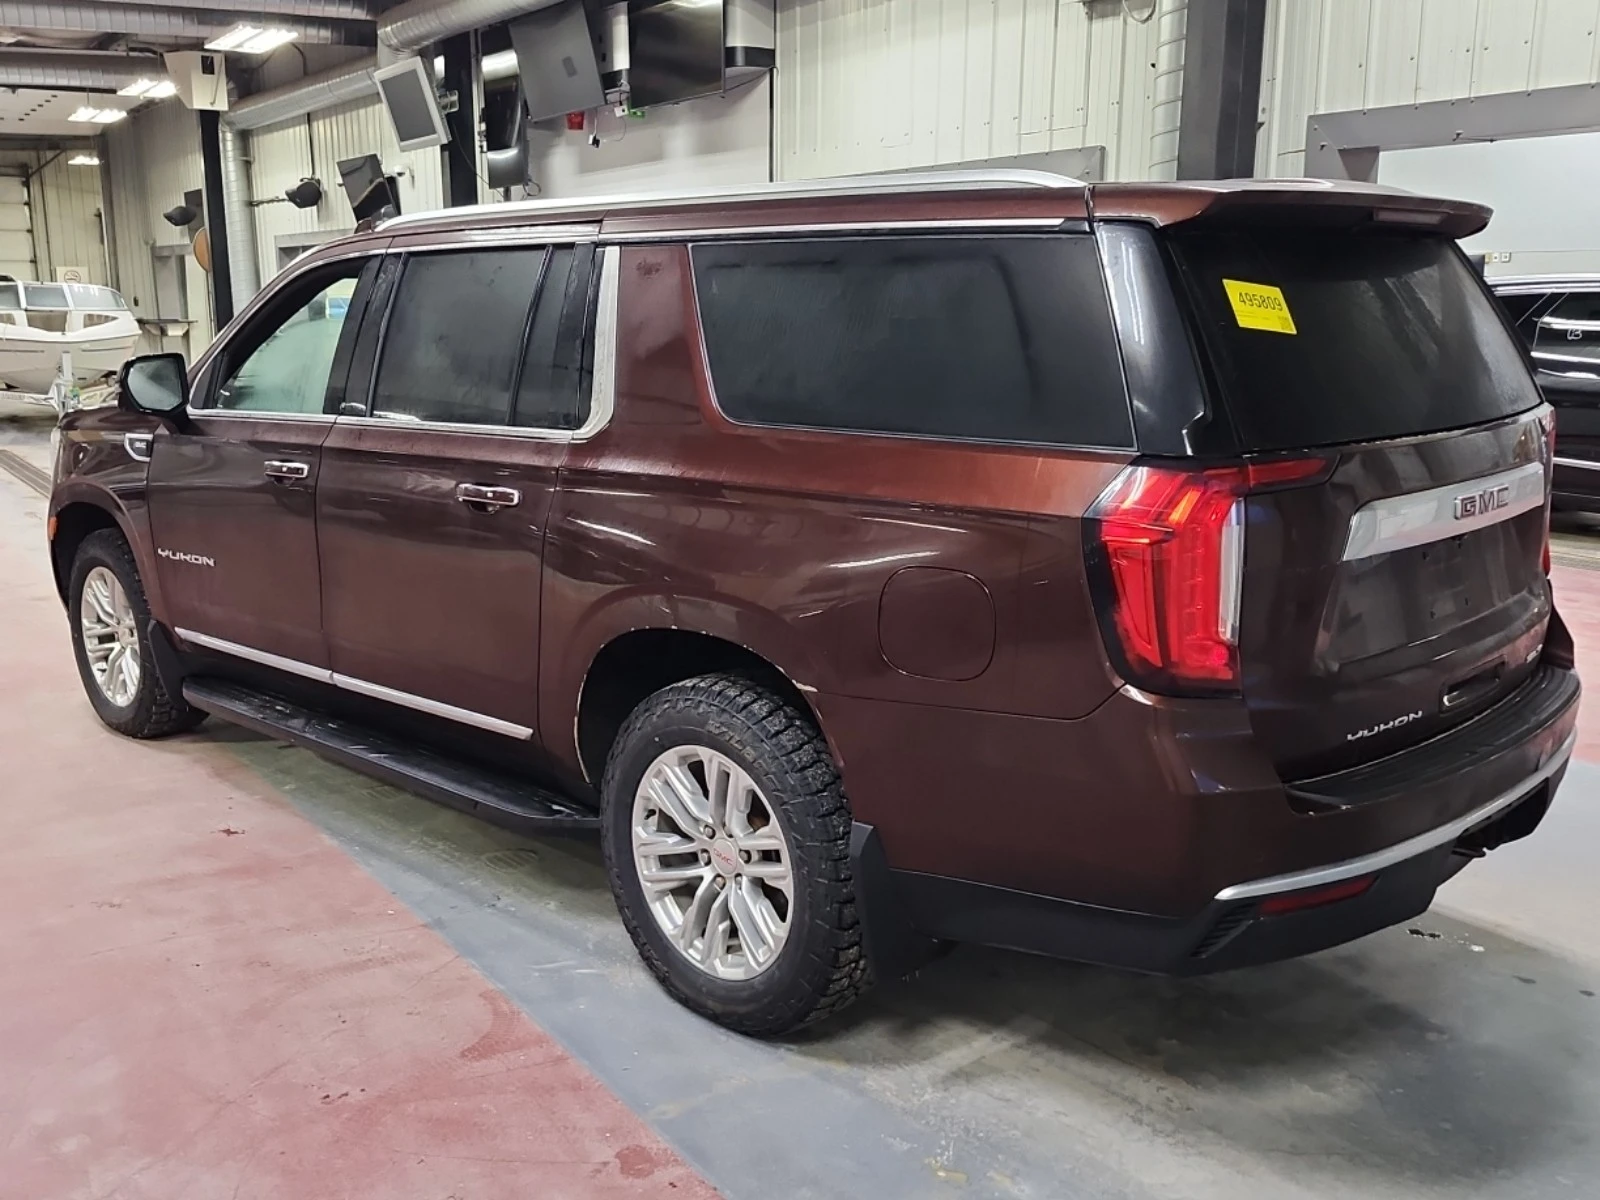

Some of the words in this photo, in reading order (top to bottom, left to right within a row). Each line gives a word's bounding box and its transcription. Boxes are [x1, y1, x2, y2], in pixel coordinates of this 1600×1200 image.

[1238, 292, 1283, 312] 495809
[1454, 485, 1509, 519] GMC
[157, 548, 215, 567] YUKON
[1347, 710, 1423, 741] YUKON
[713, 848, 733, 866] GMC
